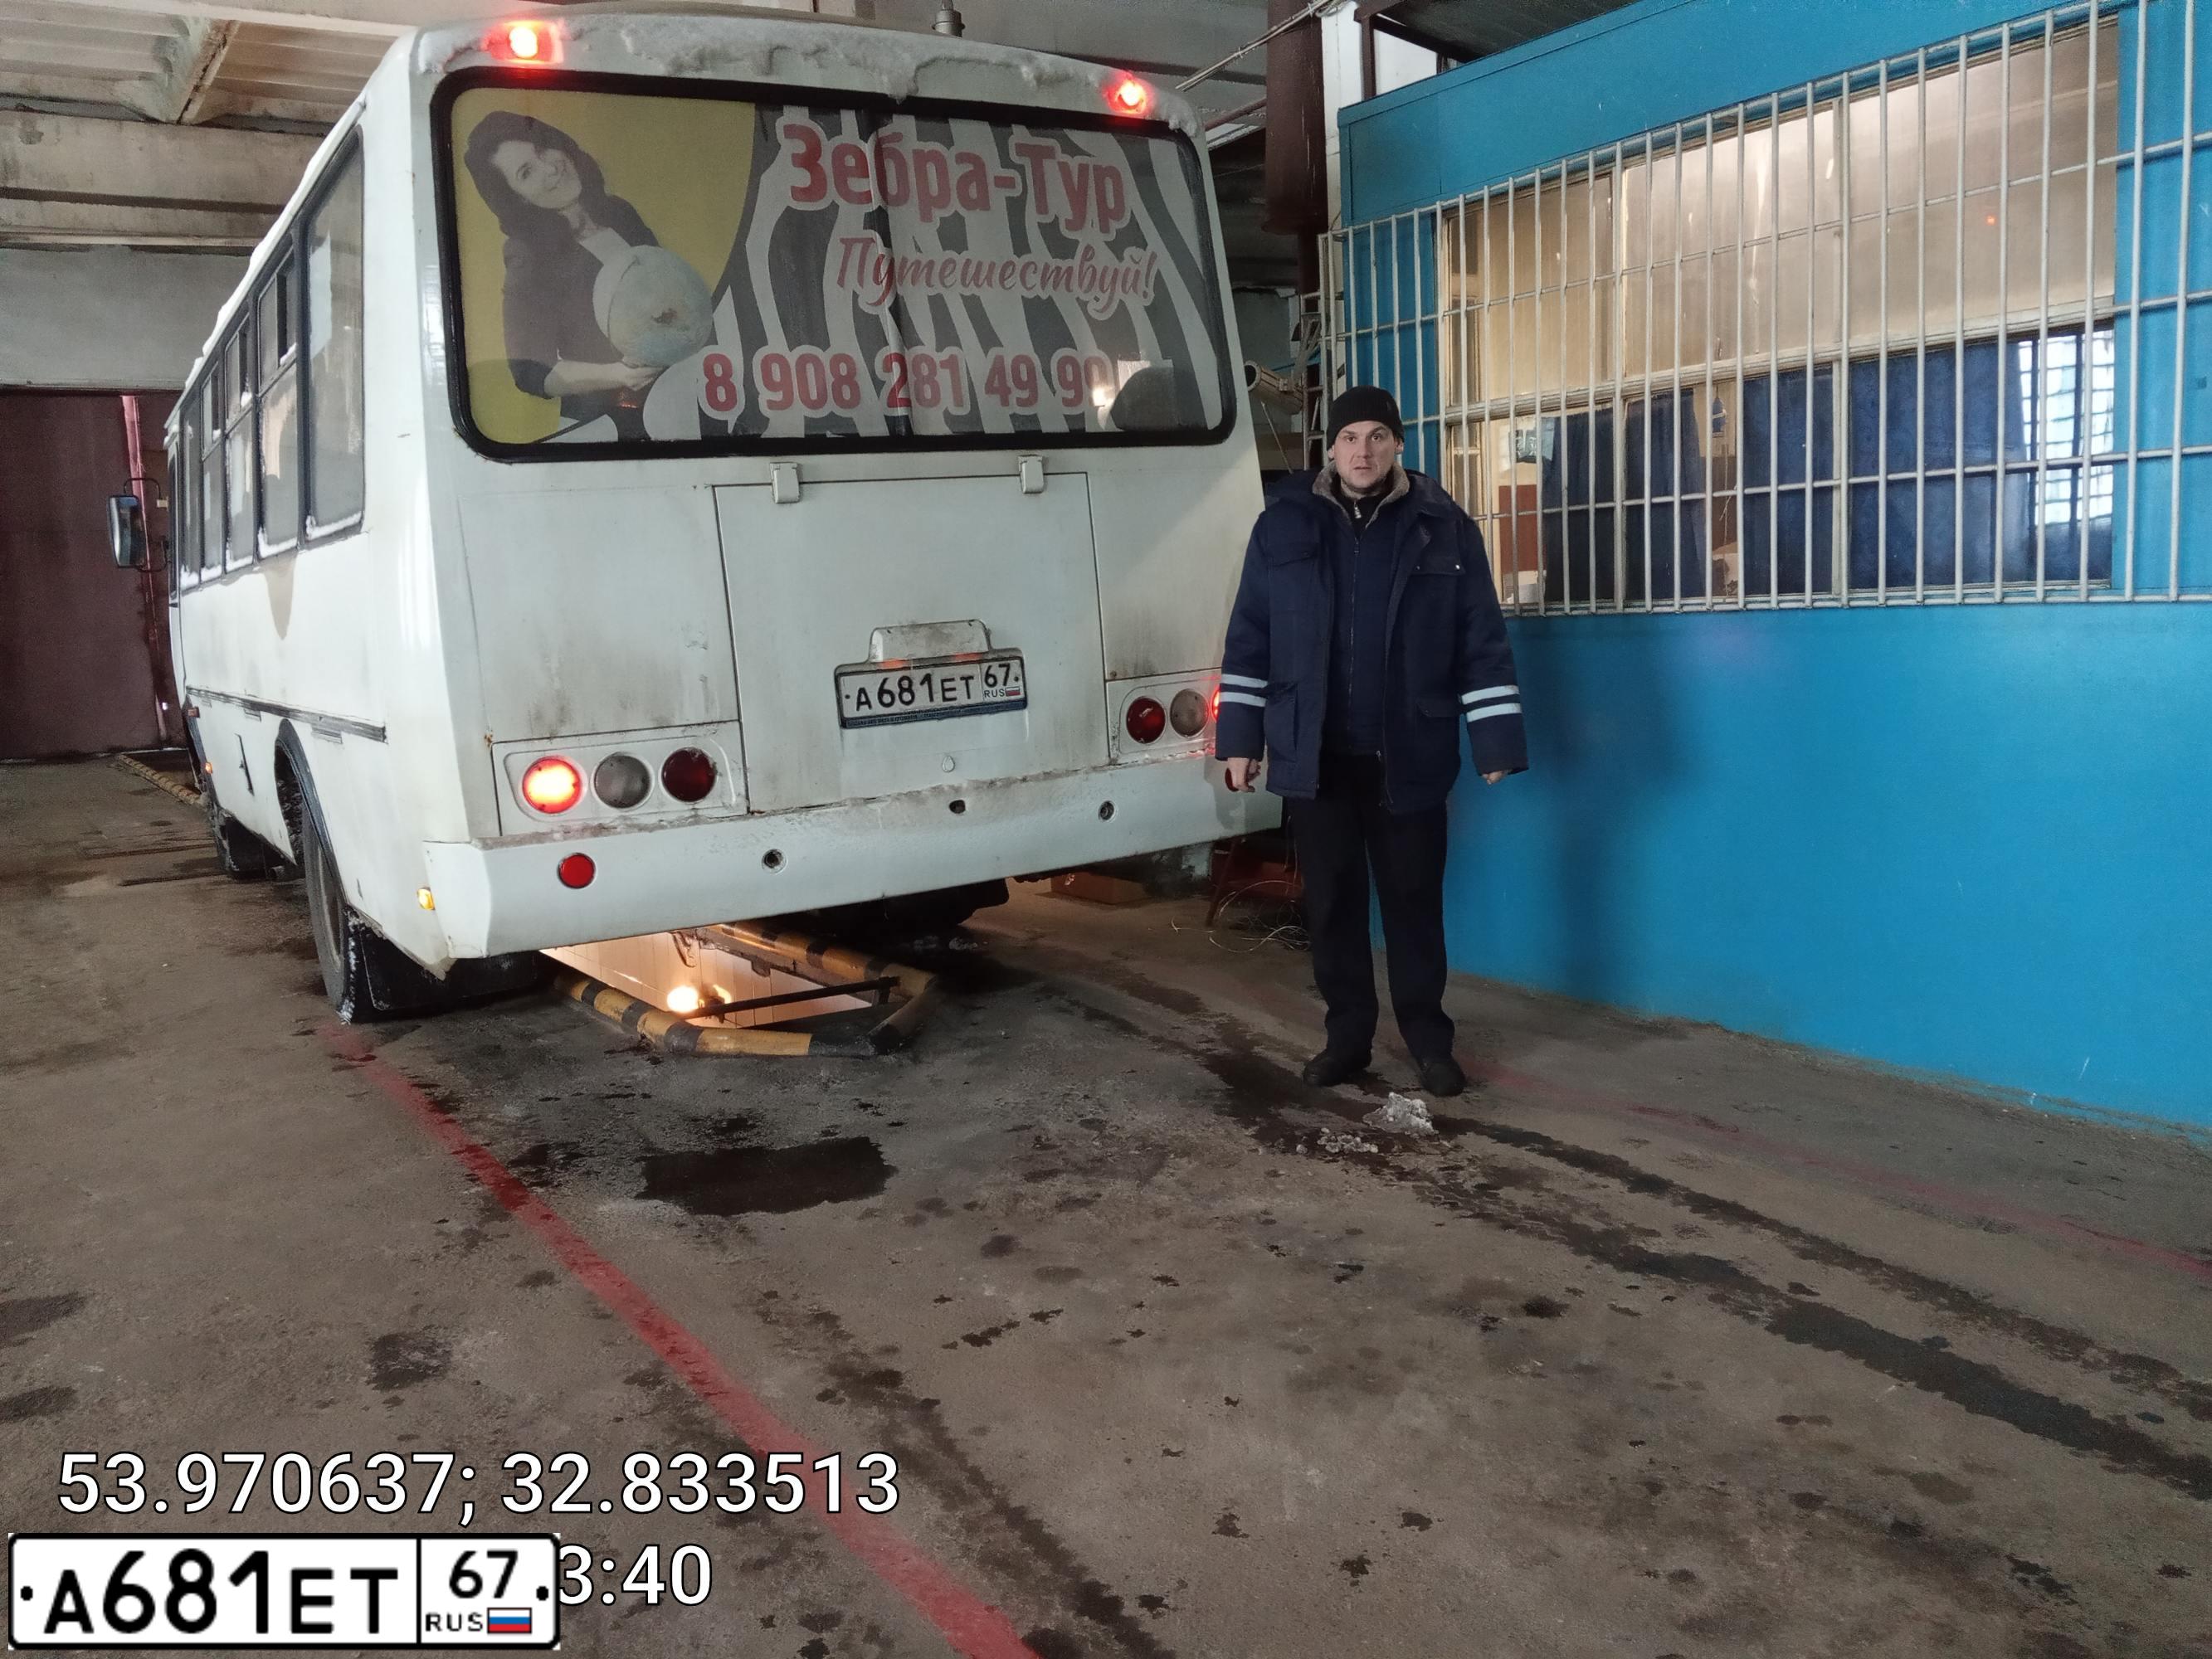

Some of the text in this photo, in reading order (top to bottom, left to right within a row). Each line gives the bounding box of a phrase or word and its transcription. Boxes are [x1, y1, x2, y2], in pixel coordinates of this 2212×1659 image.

[783, 124, 1125, 235] Зебра-Тур
[836, 236, 1157, 314] Путешествуй!
[703, 353, 738, 412] 8
[760, 353, 861, 411] 908
[882, 352, 964, 408] 281
[984, 354, 1039, 407] 49
[983, 688, 1005, 698] RUS
[984, 663, 1011, 688] 67
